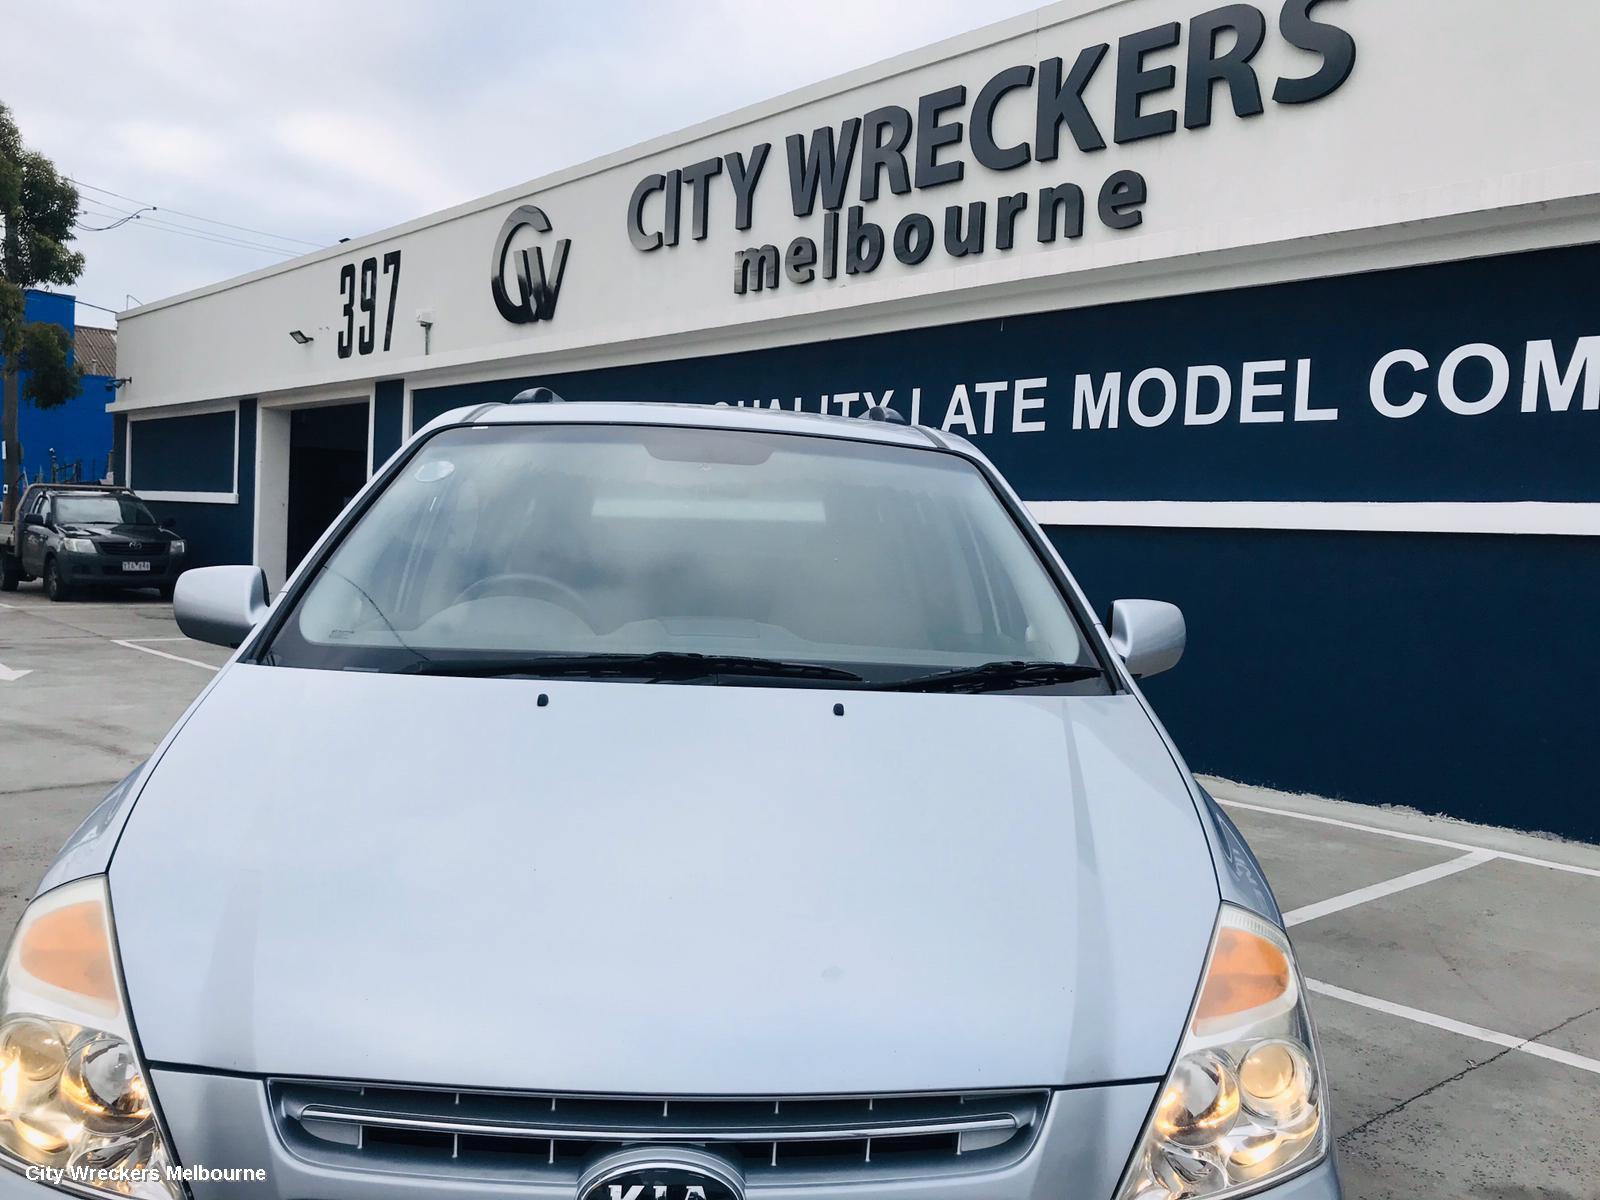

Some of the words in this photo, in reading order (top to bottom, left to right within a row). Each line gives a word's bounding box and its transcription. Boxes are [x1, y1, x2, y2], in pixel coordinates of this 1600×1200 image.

[627, 142, 771, 252] CITY
[786, 0, 1356, 217] WRECKERS
[734, 169, 1148, 296] melbourne
[337, 250, 402, 360] 397
[1072, 358, 1339, 430] MODEL
[1369, 335, 1600, 419] COM
